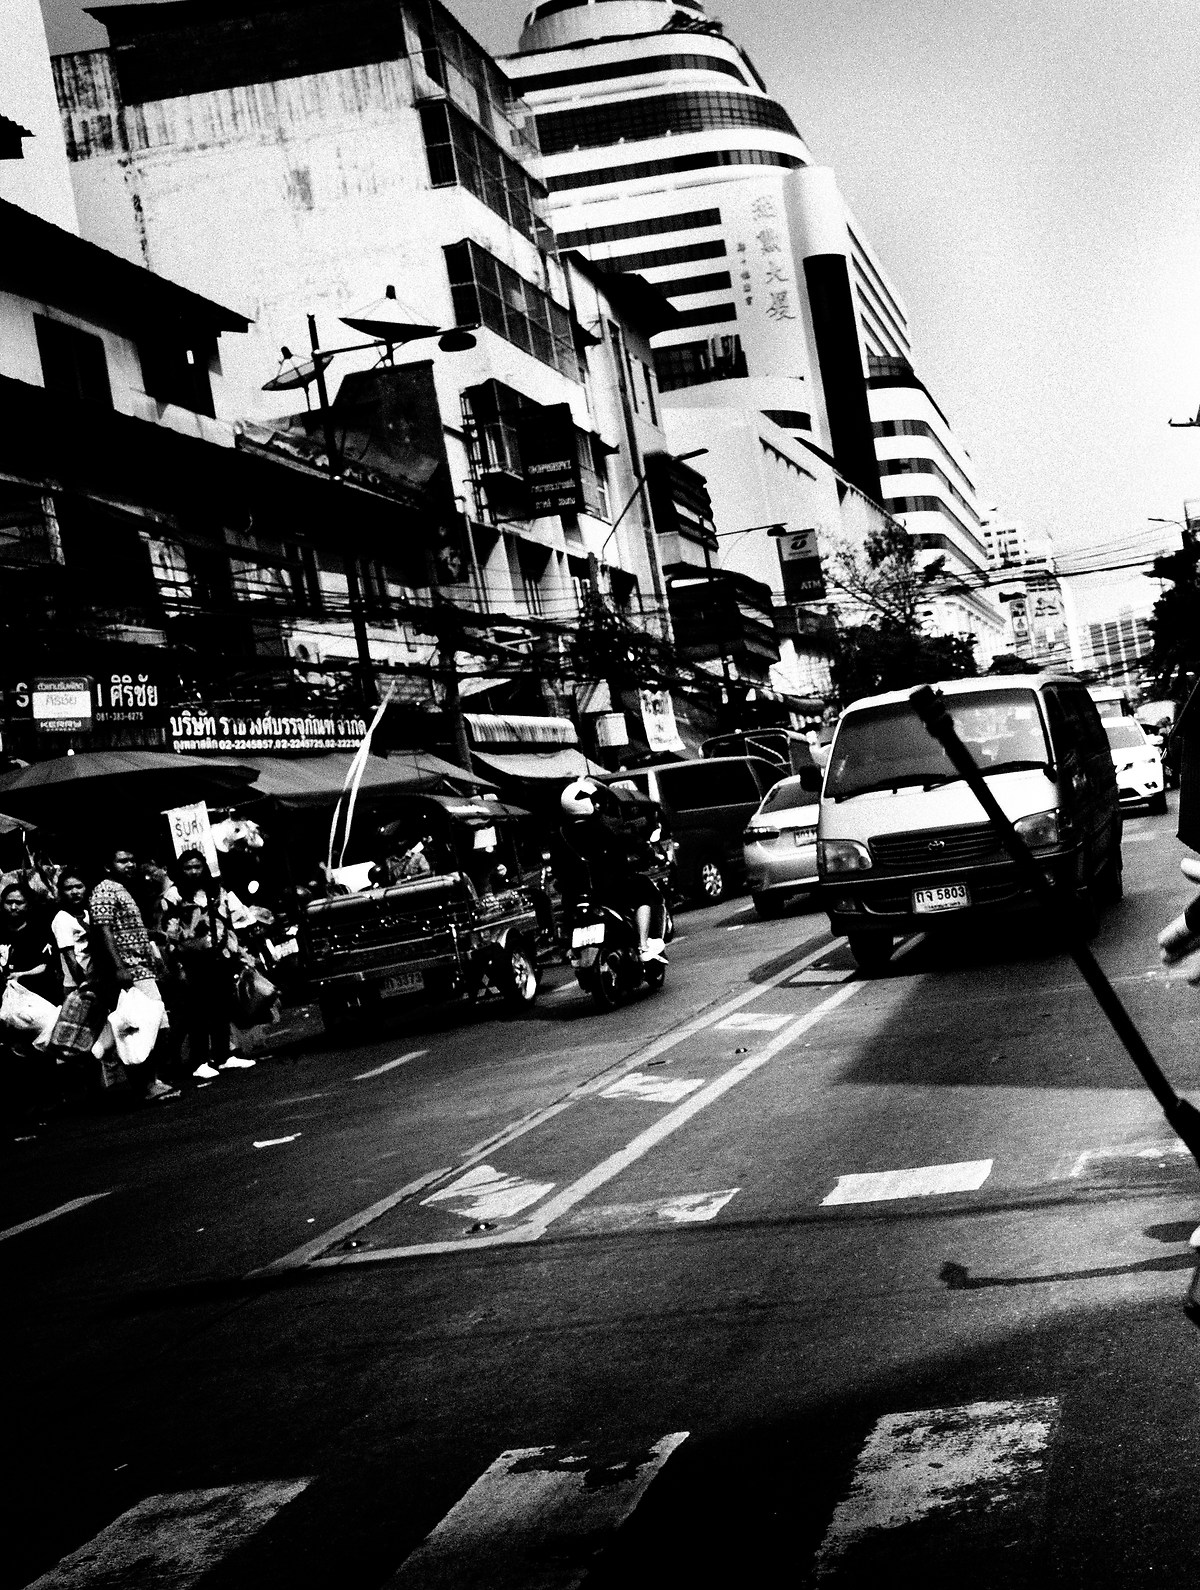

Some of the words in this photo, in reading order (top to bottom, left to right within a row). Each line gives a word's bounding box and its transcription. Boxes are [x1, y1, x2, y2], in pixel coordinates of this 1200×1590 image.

[801, 580, 821, 590] ATM
[110, 673, 158, 707] ศิริชัย
[40, 720, 82, 729] KERRY
[170, 709, 216, 736] บริษัท
[937, 886, 966, 900] 5803
